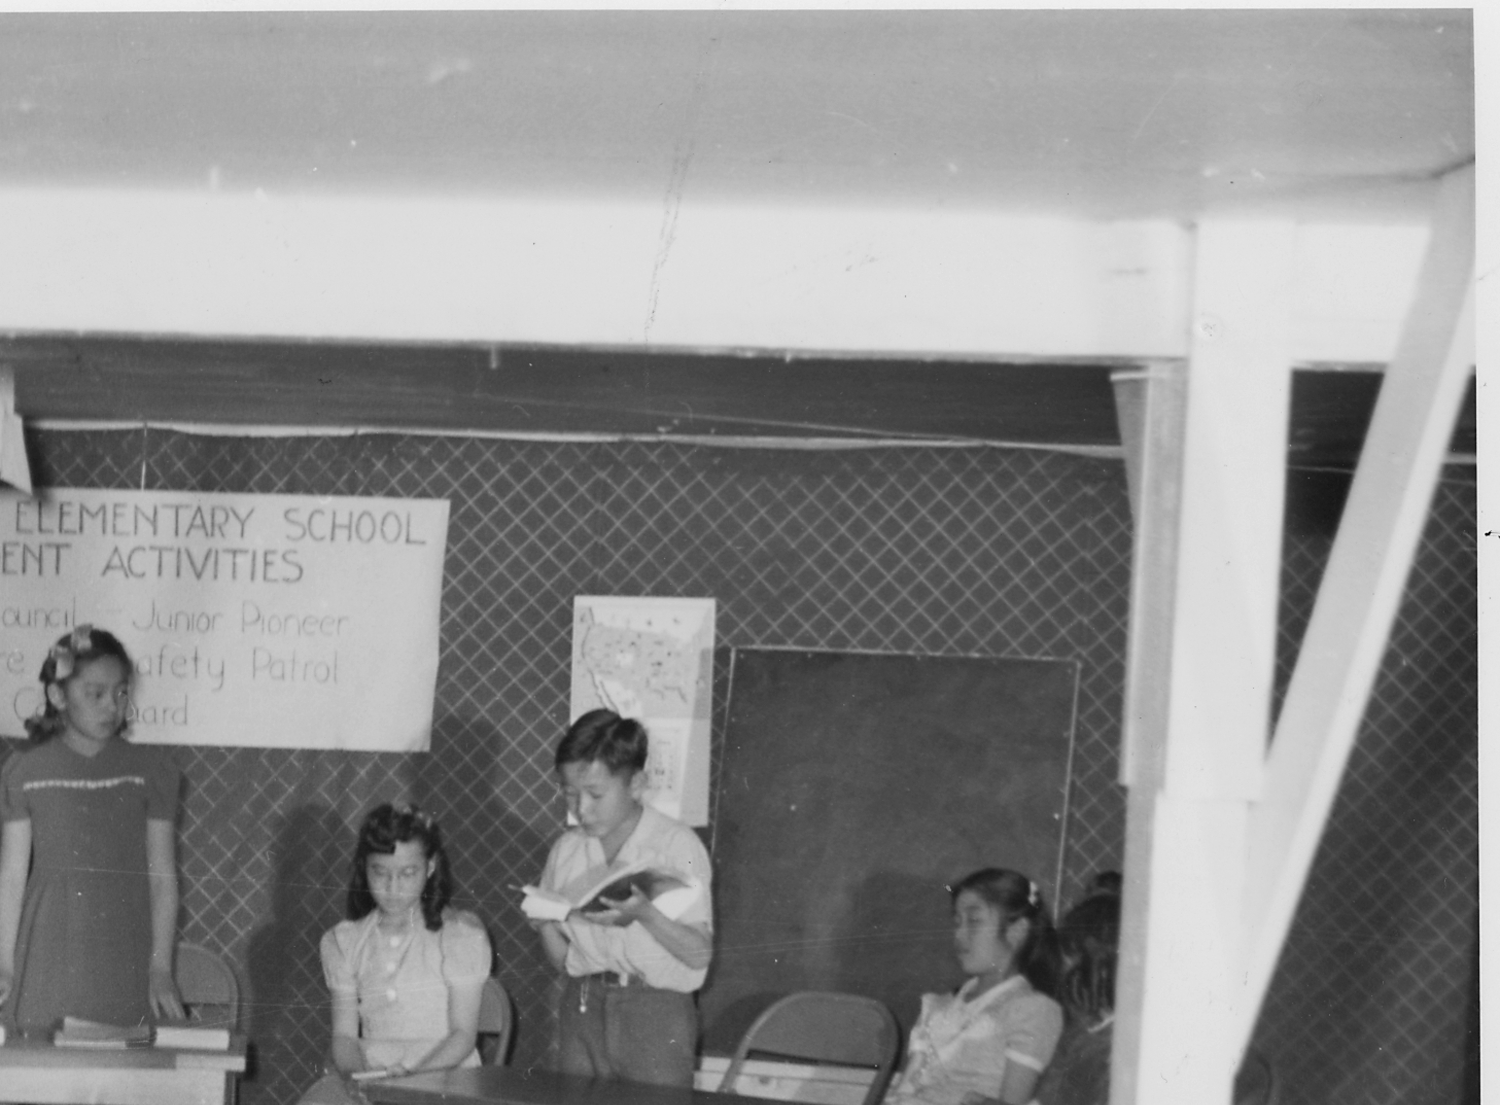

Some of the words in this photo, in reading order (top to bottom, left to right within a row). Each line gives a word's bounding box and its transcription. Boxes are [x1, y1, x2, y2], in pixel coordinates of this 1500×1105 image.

[14, 500, 255, 539] ELEMENTARY
[283, 507, 427, 546] SCHOOL
[101, 545, 304, 583] ACTIVITIES
[132, 599, 224, 635] Junior
[240, 599, 350, 637] Pioneer
[134, 643, 225, 692] afety
[251, 646, 339, 685] Patrol
